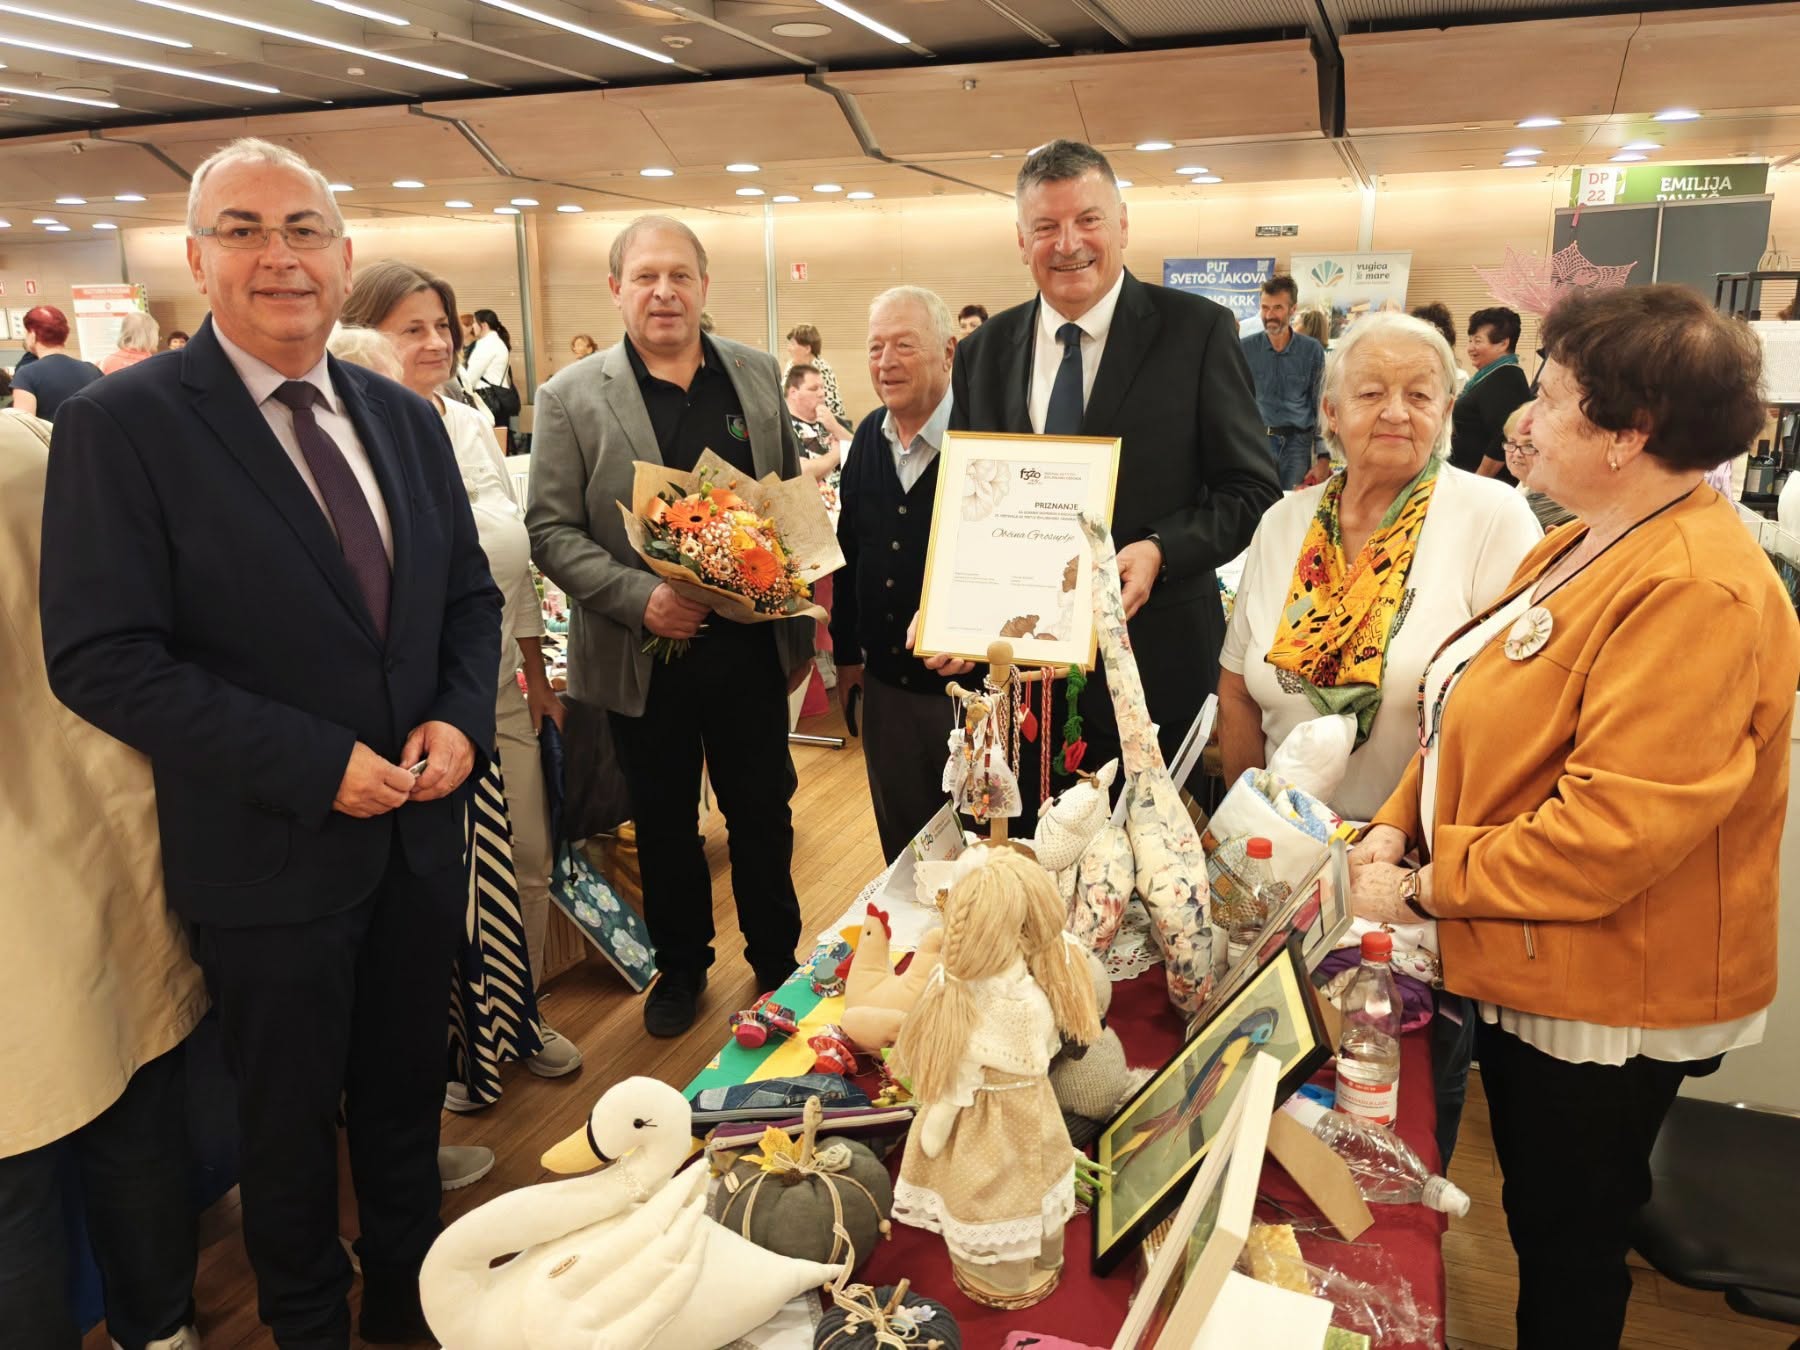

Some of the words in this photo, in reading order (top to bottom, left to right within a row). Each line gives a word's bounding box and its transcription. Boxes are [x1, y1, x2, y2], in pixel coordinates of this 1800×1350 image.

[1588, 172, 1609, 185] DP
[1660, 176, 1733, 192] EMILIJA
[1587, 190, 1606, 202] 22
[1206, 262, 1229, 273] PUT
[1357, 261, 1388, 272] vugica
[1169, 273, 1216, 285] SVETOG
[1218, 273, 1267, 284] JAKOVA
[1230, 295, 1256, 306] KRK
[1034, 502, 1079, 511] PRIZNANJE
